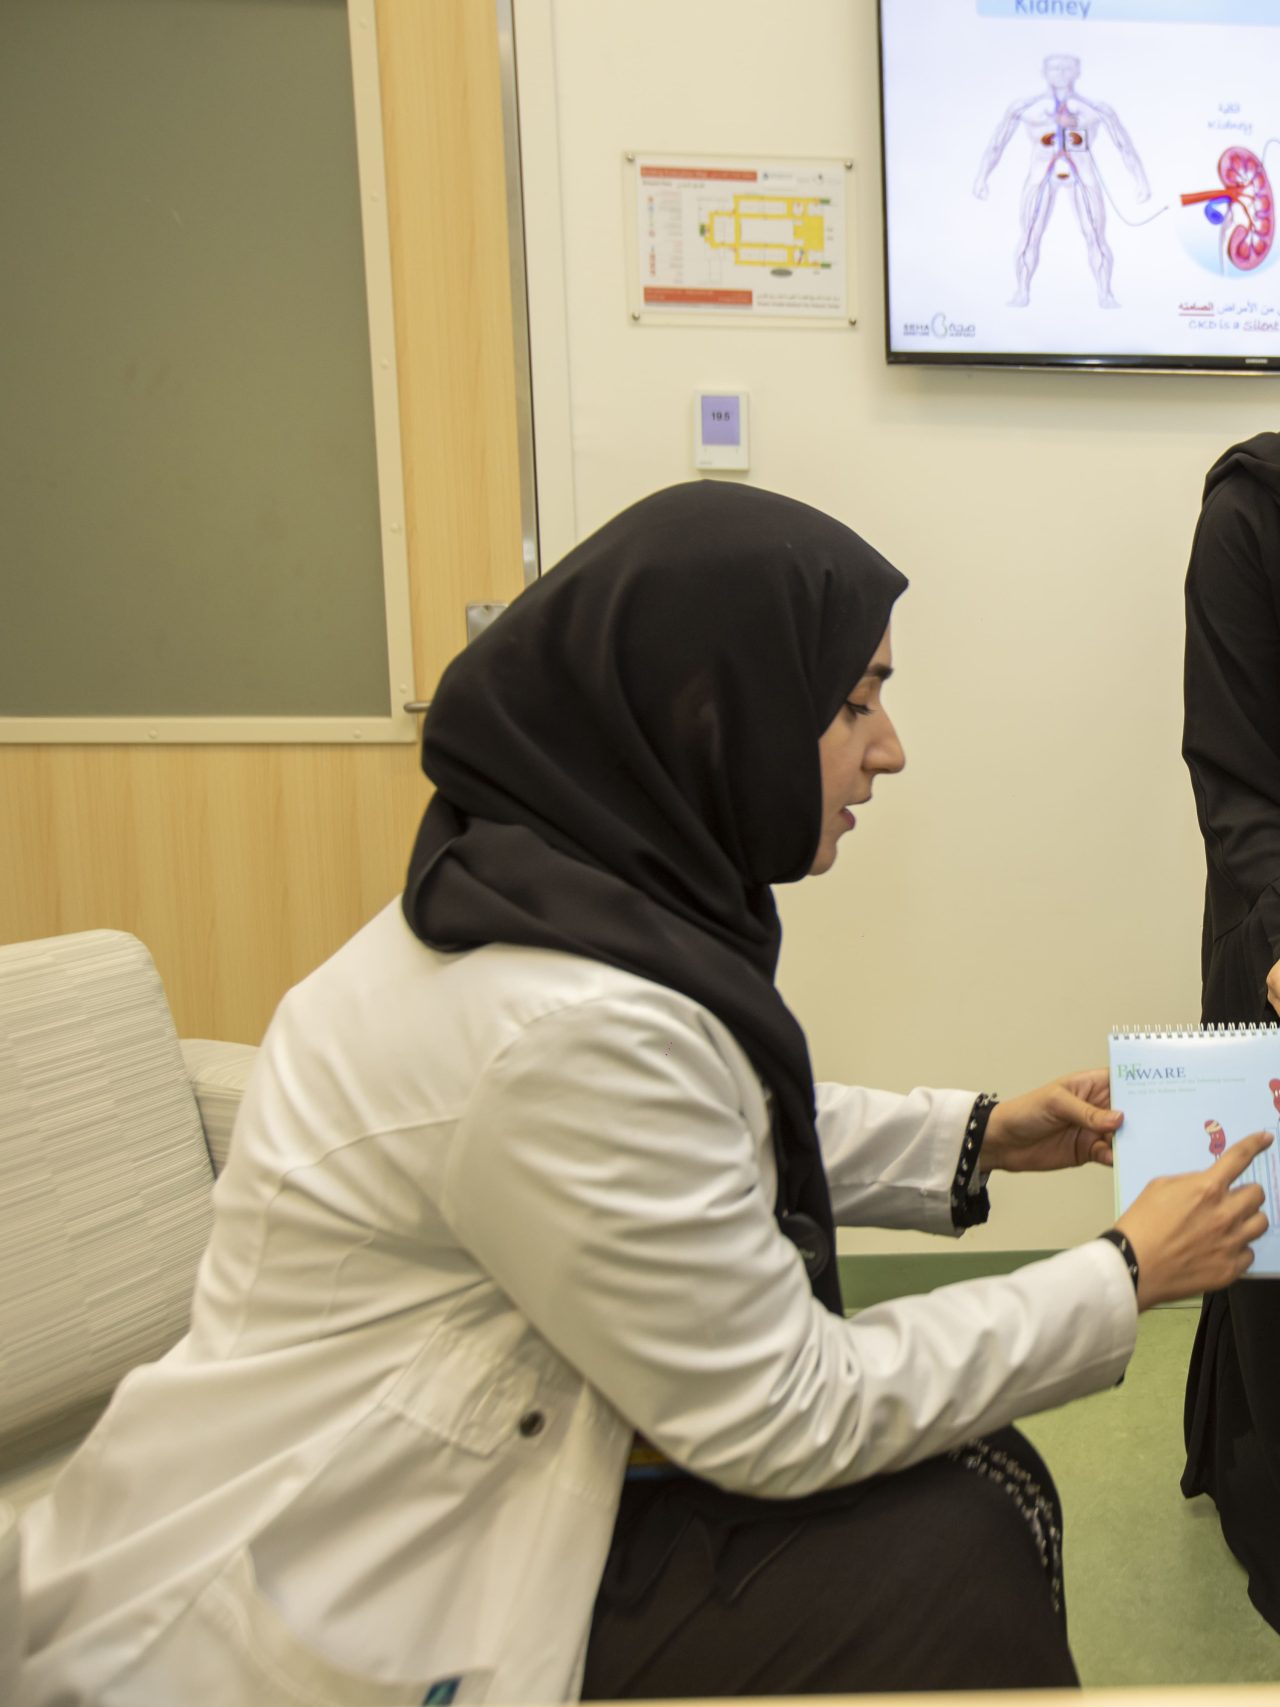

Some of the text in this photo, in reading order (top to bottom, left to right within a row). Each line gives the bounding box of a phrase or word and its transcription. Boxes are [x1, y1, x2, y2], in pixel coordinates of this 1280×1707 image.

[1015, 0, 1092, 20] Kidney
[1261, 306, 1274, 316] من
[712, 411, 731, 421] 19.5
[1125, 1065, 1187, 1081] AWARE
